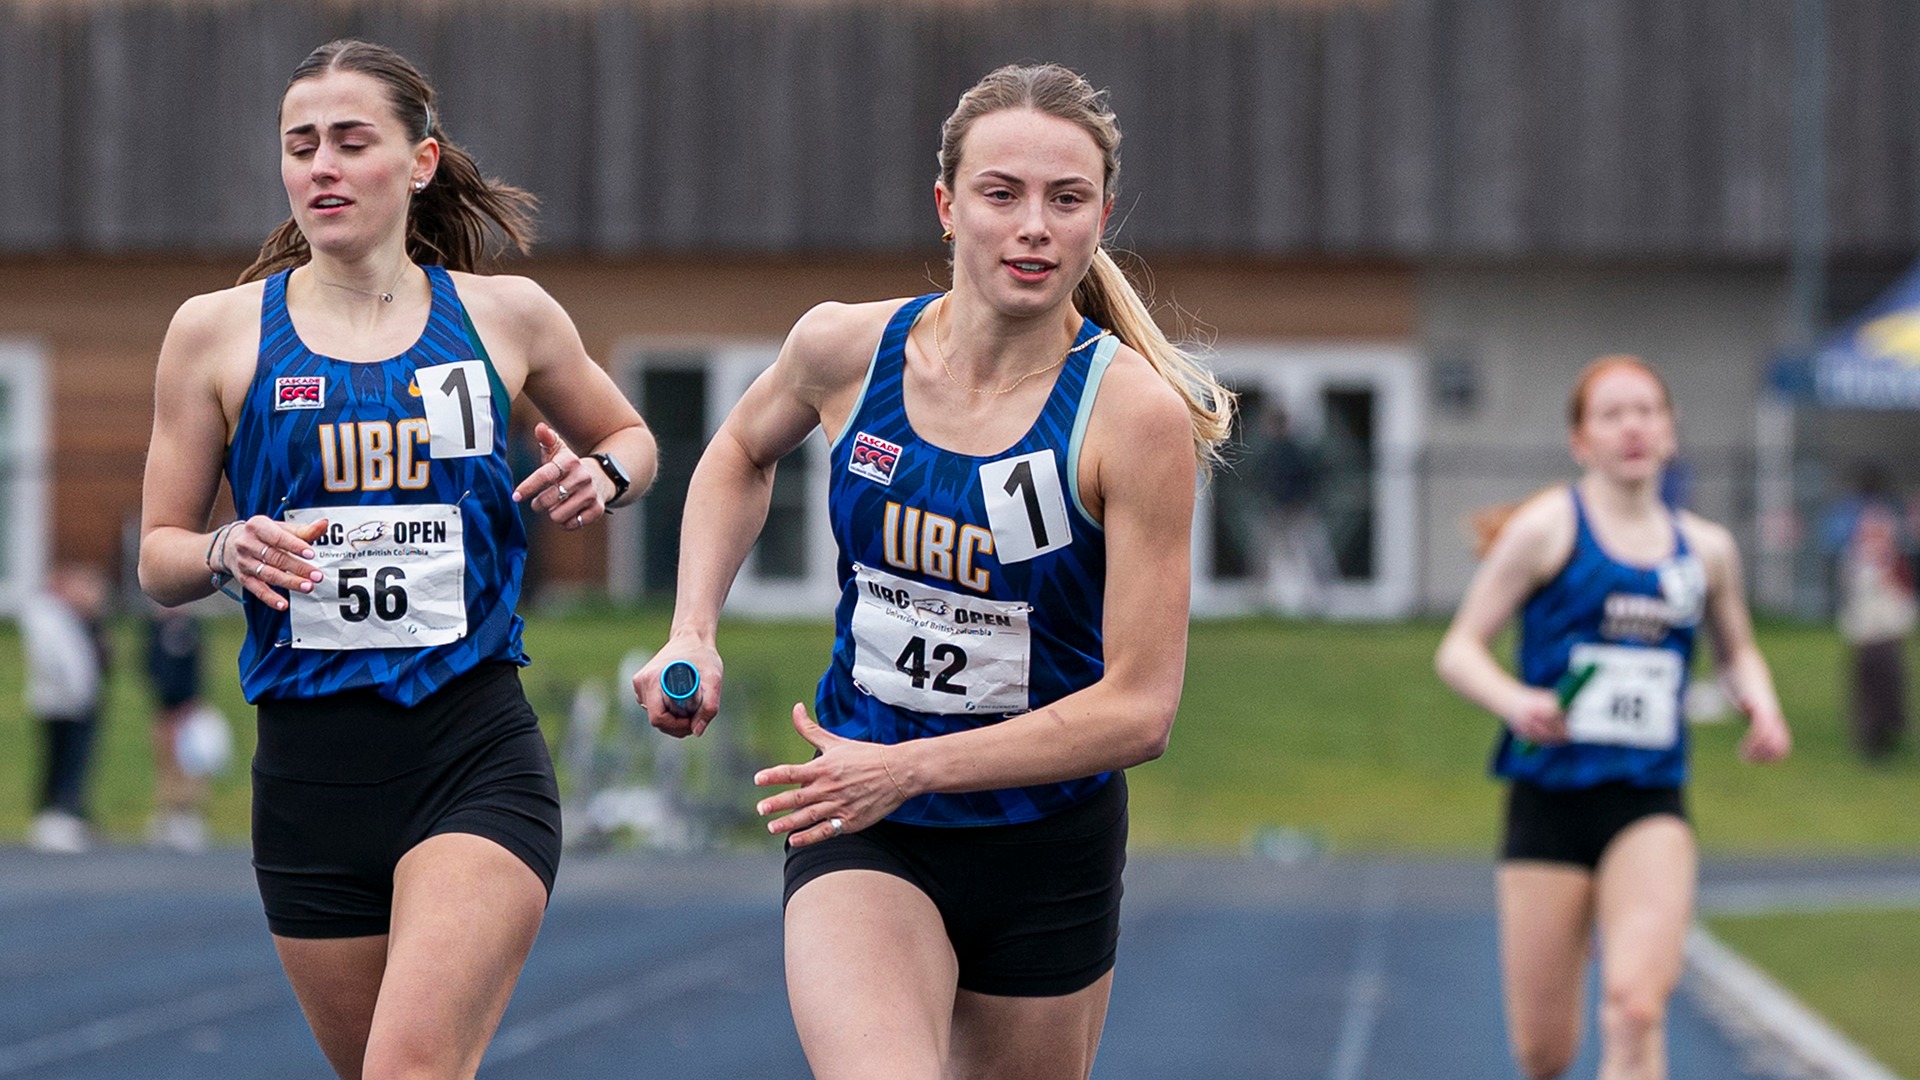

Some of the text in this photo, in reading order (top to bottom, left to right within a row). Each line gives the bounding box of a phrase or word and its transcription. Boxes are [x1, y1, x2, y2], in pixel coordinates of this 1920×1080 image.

[280, 386, 319, 400] CCC
[440, 367, 476, 450] 1
[318, 418, 430, 493] UBC
[855, 445, 895, 472] CCC
[857, 433, 900, 455] CASCADE
[1003, 460, 1049, 549] 1
[319, 548, 429, 559] University of British Columbia
[393, 521, 447, 544] OPEN
[882, 500, 994, 593] UBC
[338, 566, 408, 622] 56
[868, 580, 1011, 627] UBC OPEN
[930, 622, 953, 634] British
[895, 635, 967, 695] 42
